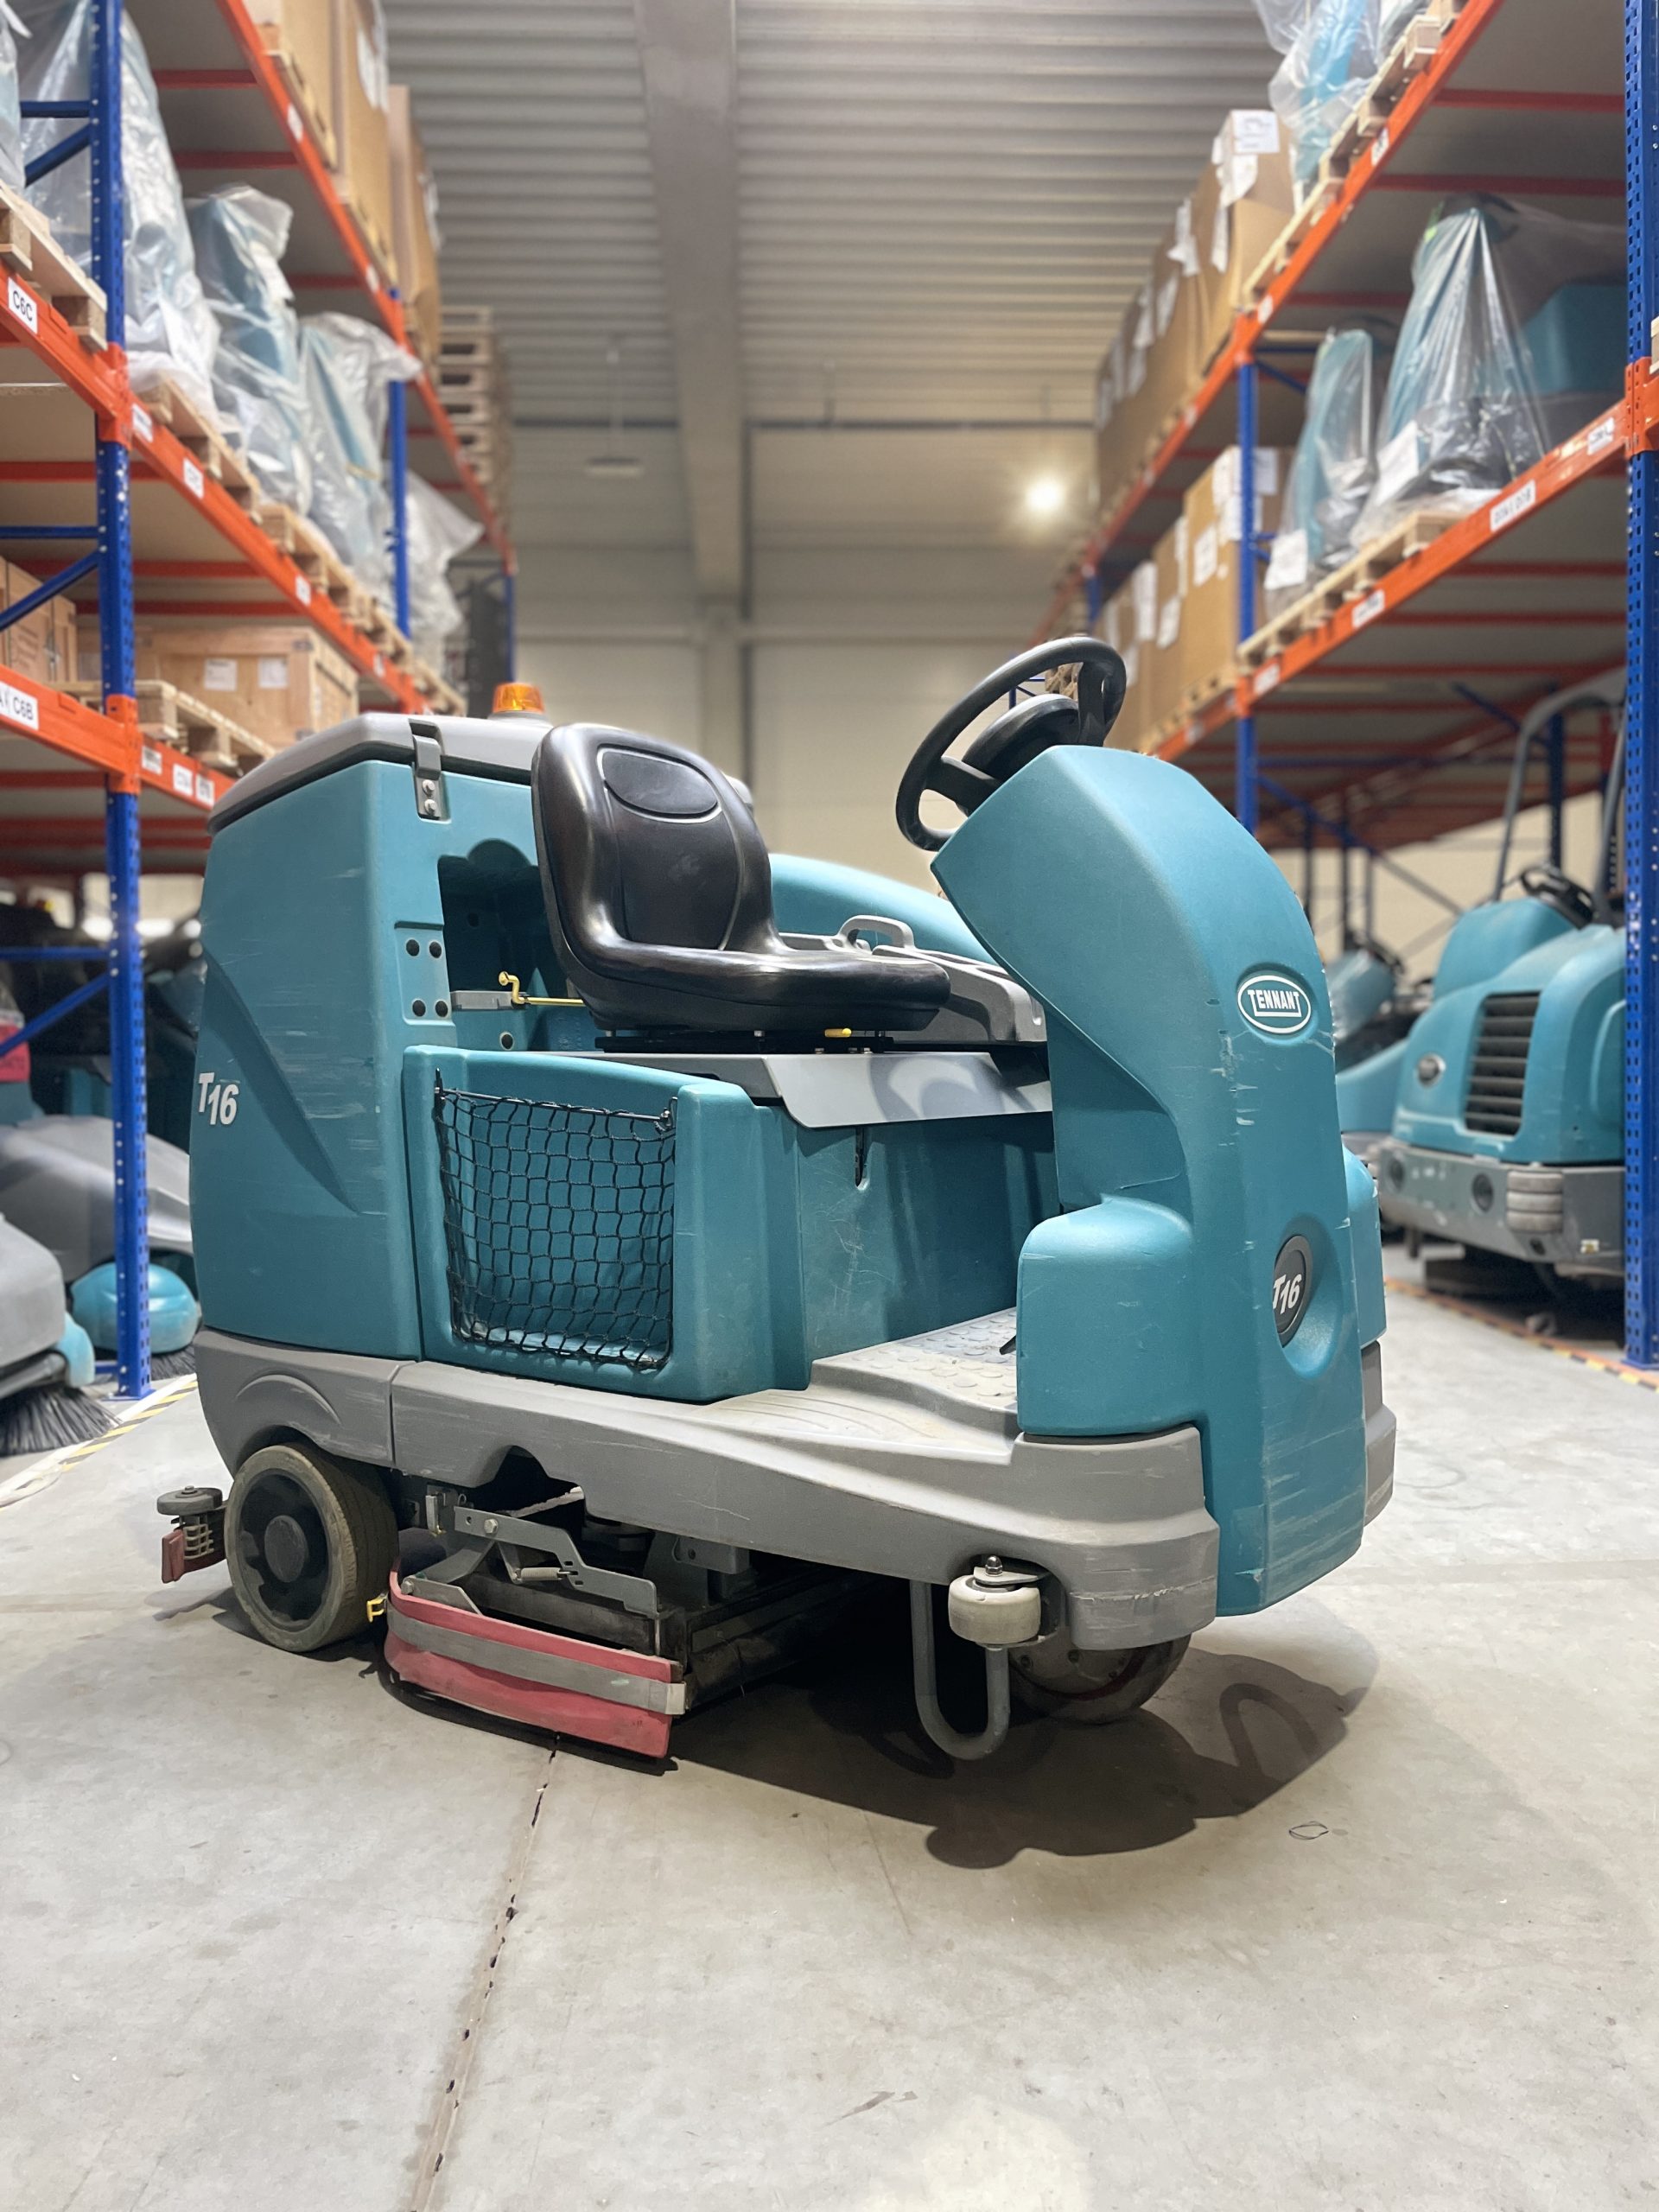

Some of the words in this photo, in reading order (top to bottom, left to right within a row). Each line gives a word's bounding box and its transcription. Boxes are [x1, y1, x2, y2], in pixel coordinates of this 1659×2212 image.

[13, 290, 33, 321] C6C
[13, 696, 34, 721] C6B
[1247, 989, 1301, 1017] TENNANT
[199, 1072, 239, 1125] T16
[1273, 1274, 1302, 1314] T16
